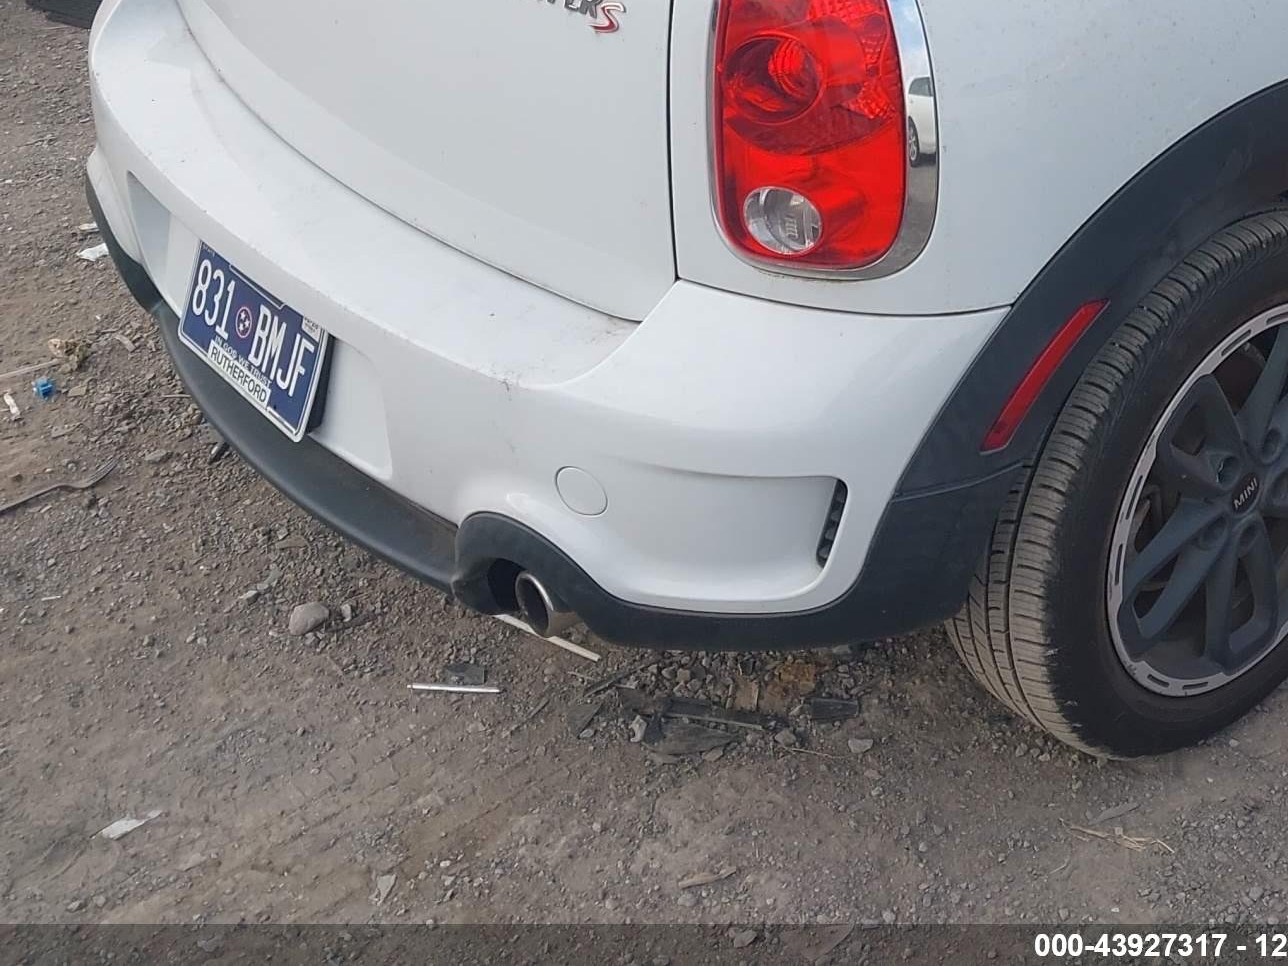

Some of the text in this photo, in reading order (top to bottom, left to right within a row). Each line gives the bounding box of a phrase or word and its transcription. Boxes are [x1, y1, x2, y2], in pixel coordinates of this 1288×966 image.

[588, 2, 626, 33] S
[192, 259, 315, 397] 831 BMJF
[210, 346, 267, 403] RUTHERFORD
[1233, 477, 1258, 509] MINI
